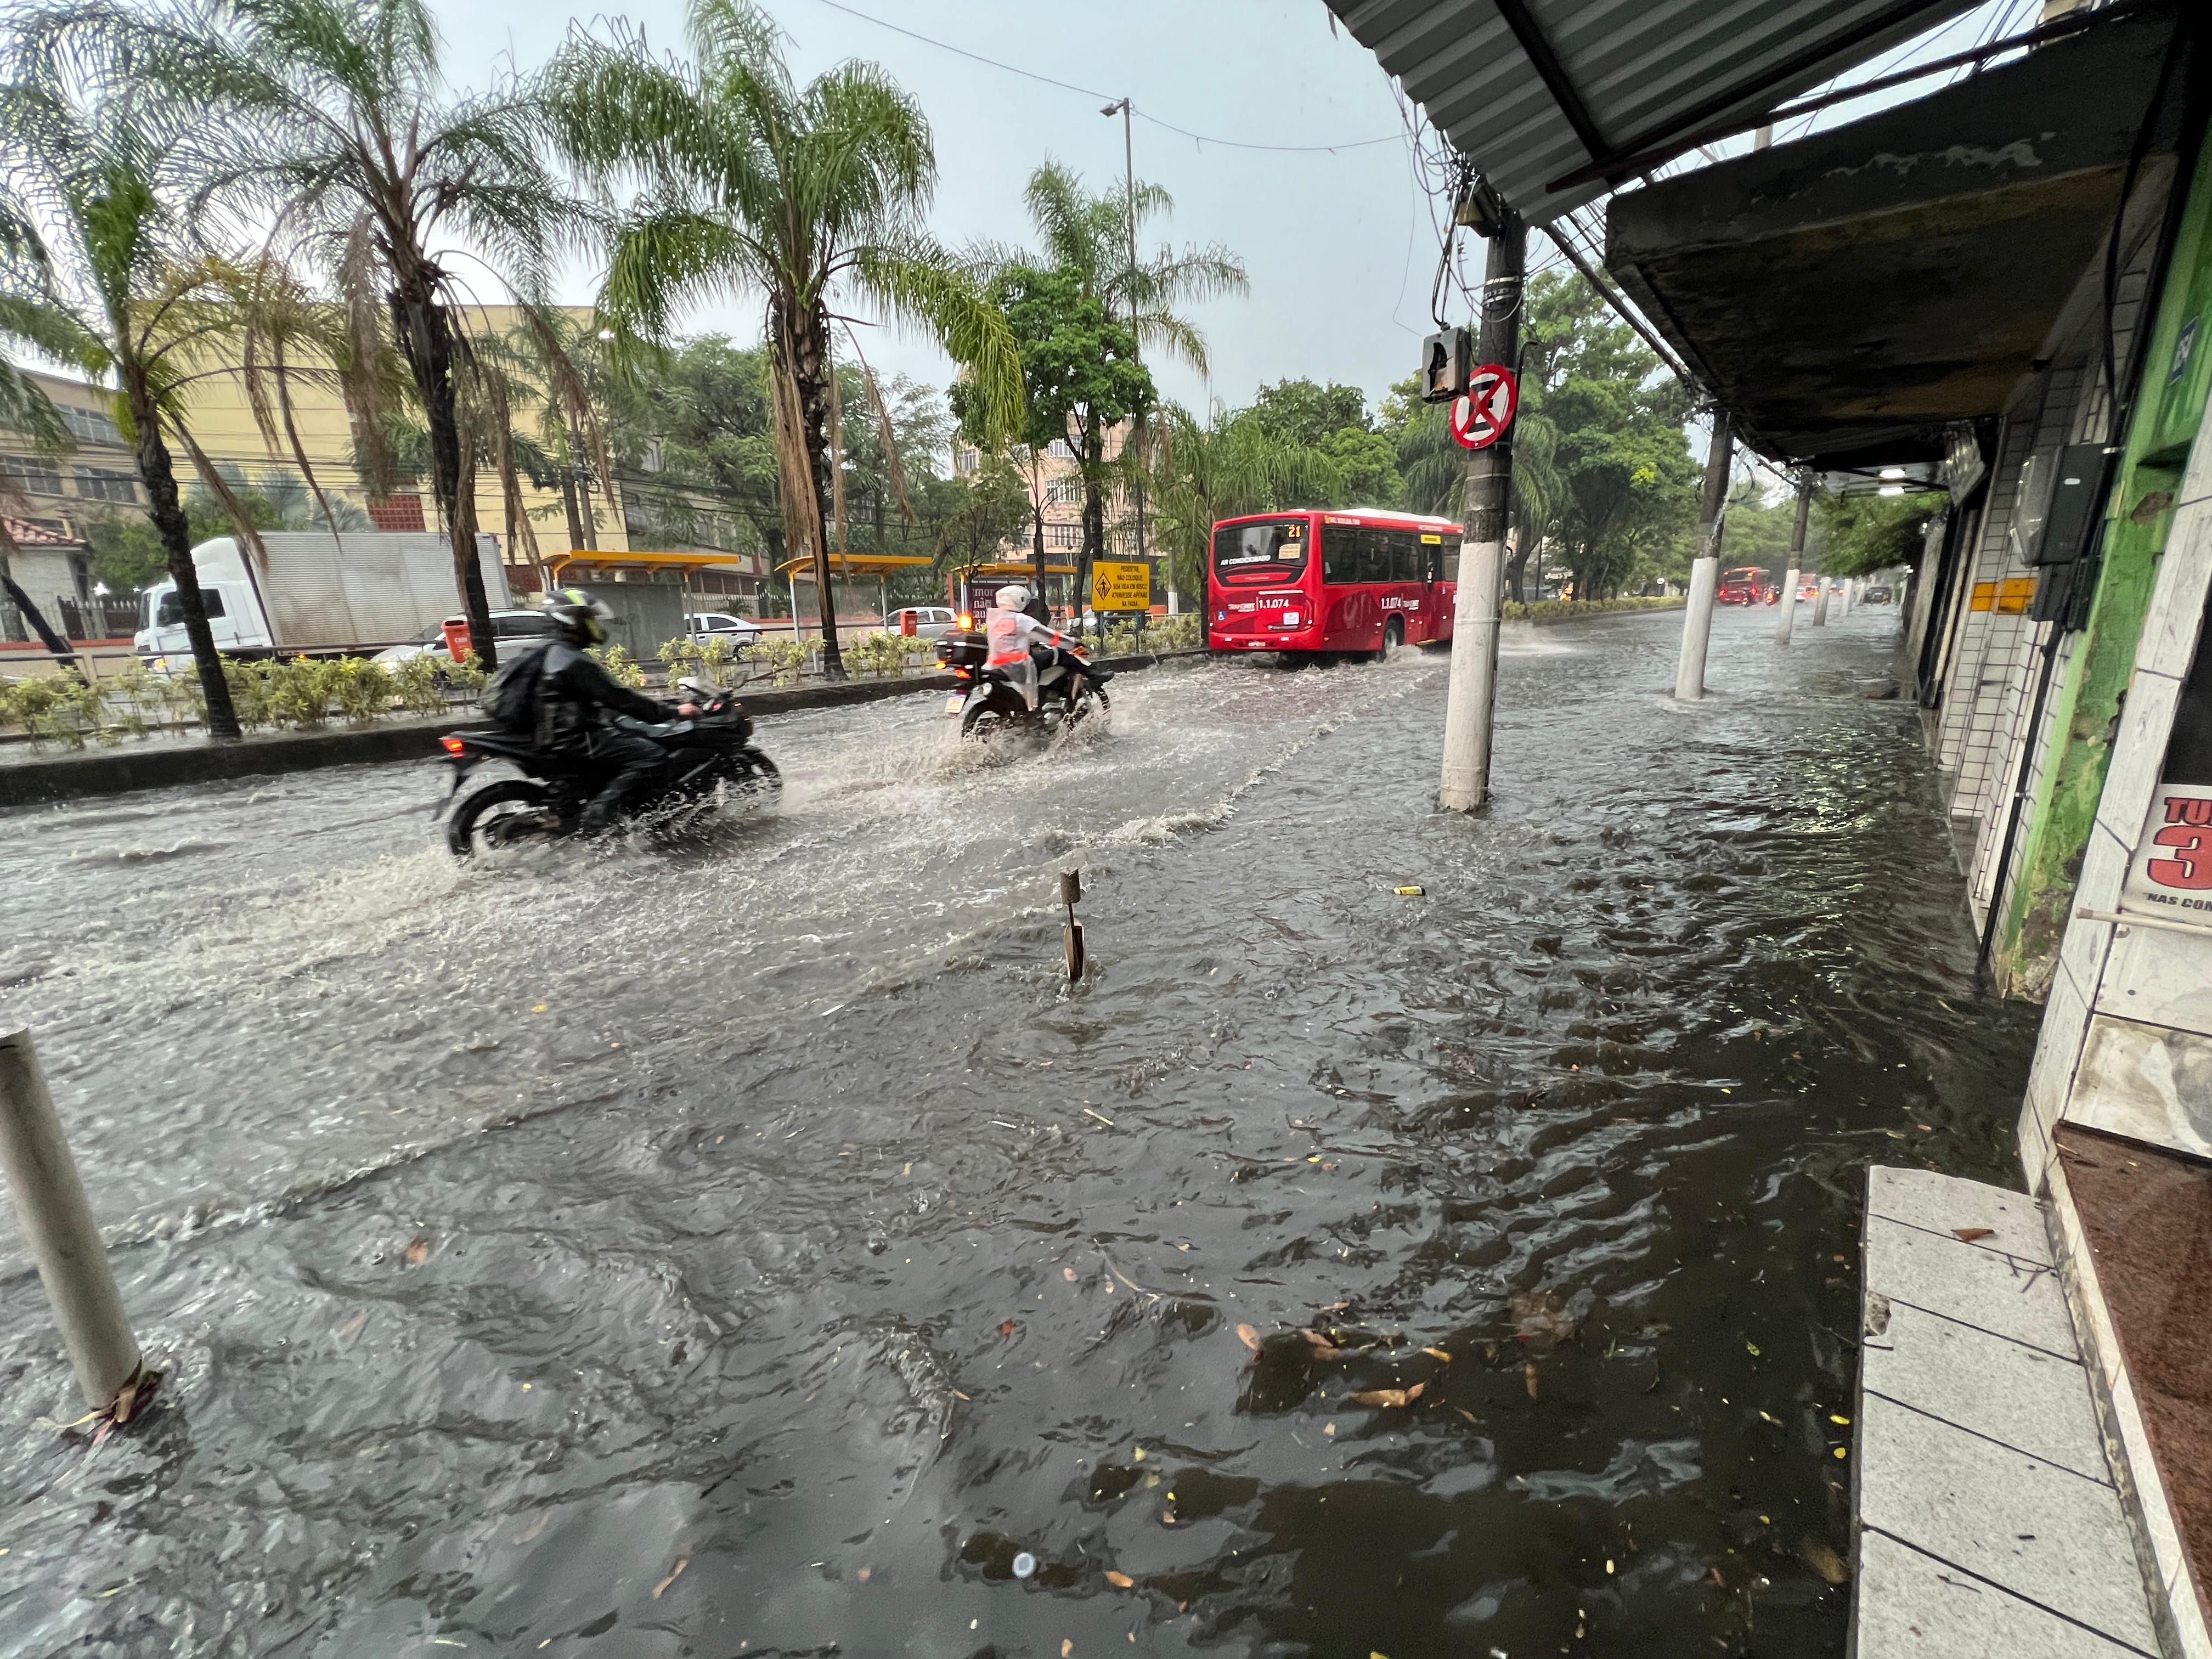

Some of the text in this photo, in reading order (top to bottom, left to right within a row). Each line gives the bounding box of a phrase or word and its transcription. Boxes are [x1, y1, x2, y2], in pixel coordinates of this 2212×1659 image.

[1288, 525, 1301, 538] 21
[973, 588, 994, 597] mor
[1259, 599, 1289, 609] 1.1.074
[2164, 797, 2212, 826] TU
